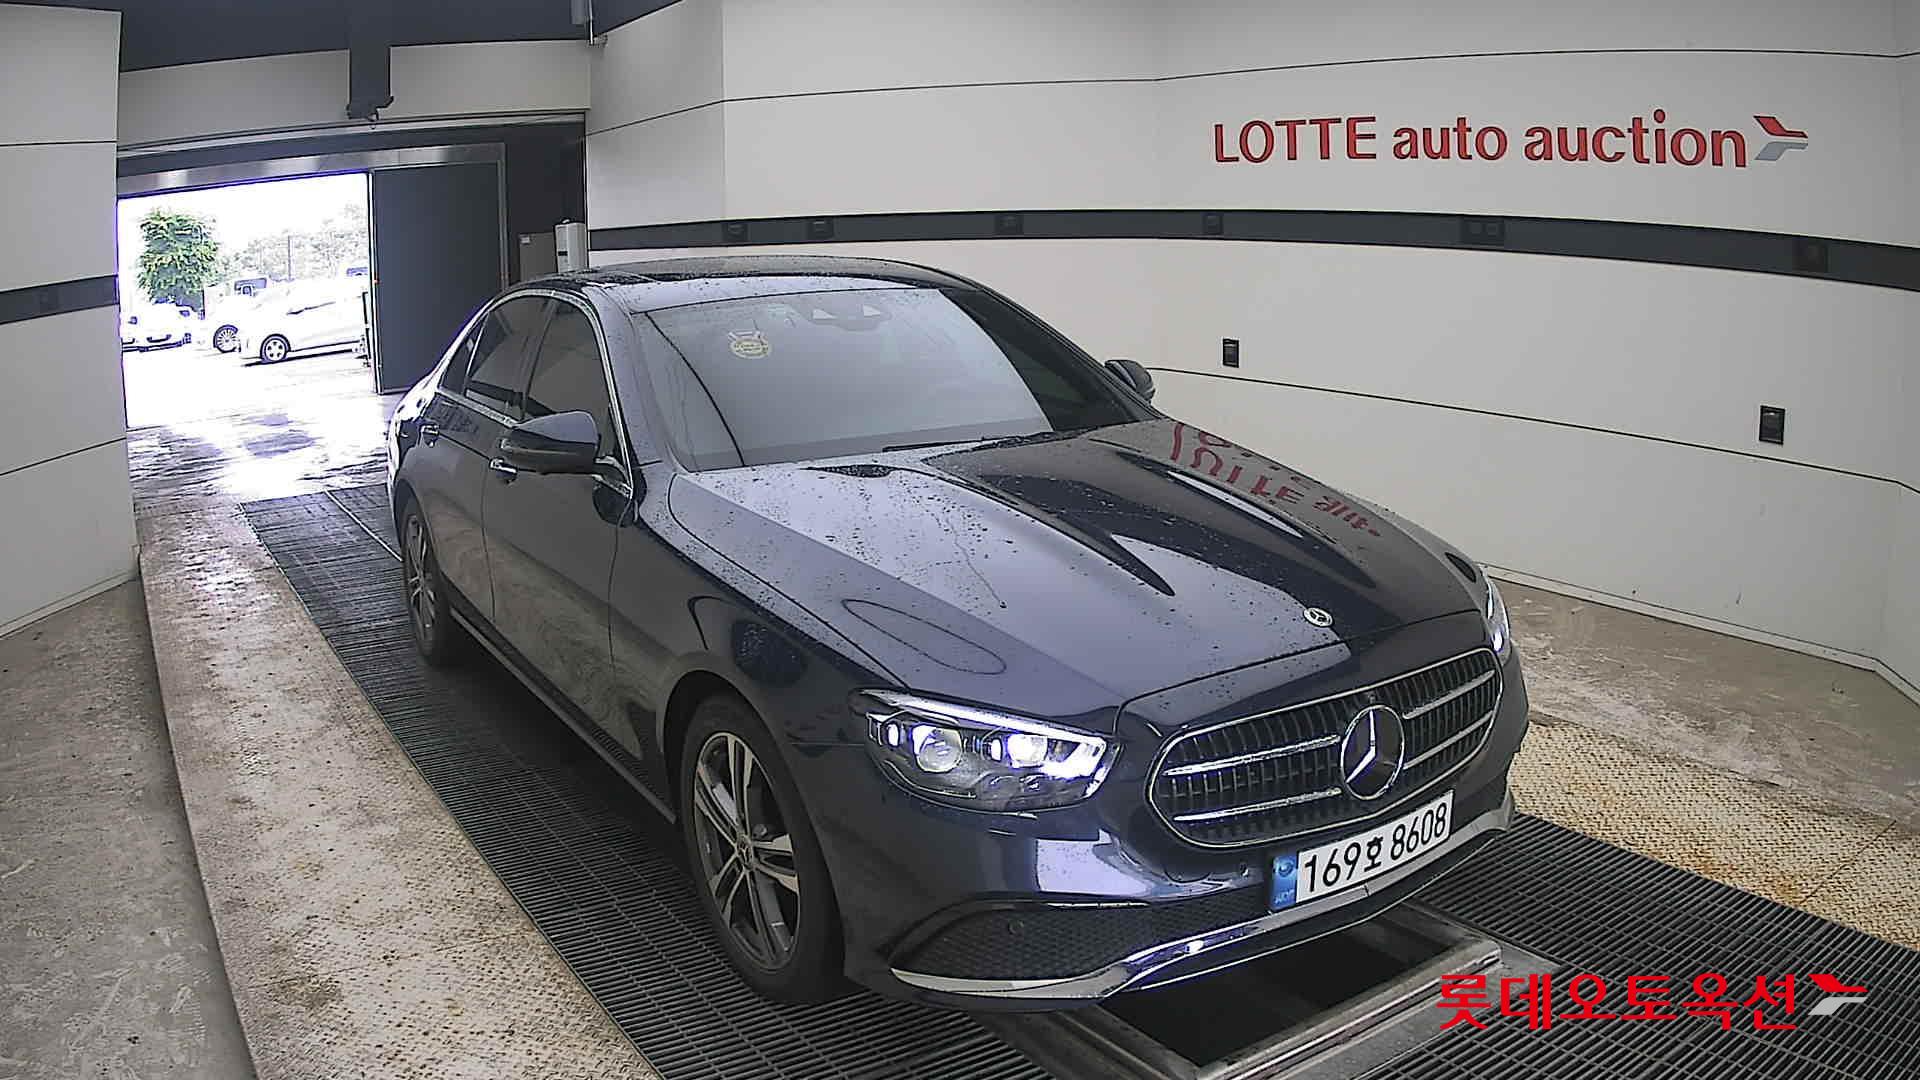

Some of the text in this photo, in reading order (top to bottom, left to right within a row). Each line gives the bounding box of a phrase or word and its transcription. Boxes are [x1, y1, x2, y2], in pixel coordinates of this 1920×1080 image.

[1214, 109, 1747, 168] LOTTE auto auction
[1304, 802, 1447, 892] 169호 8608
